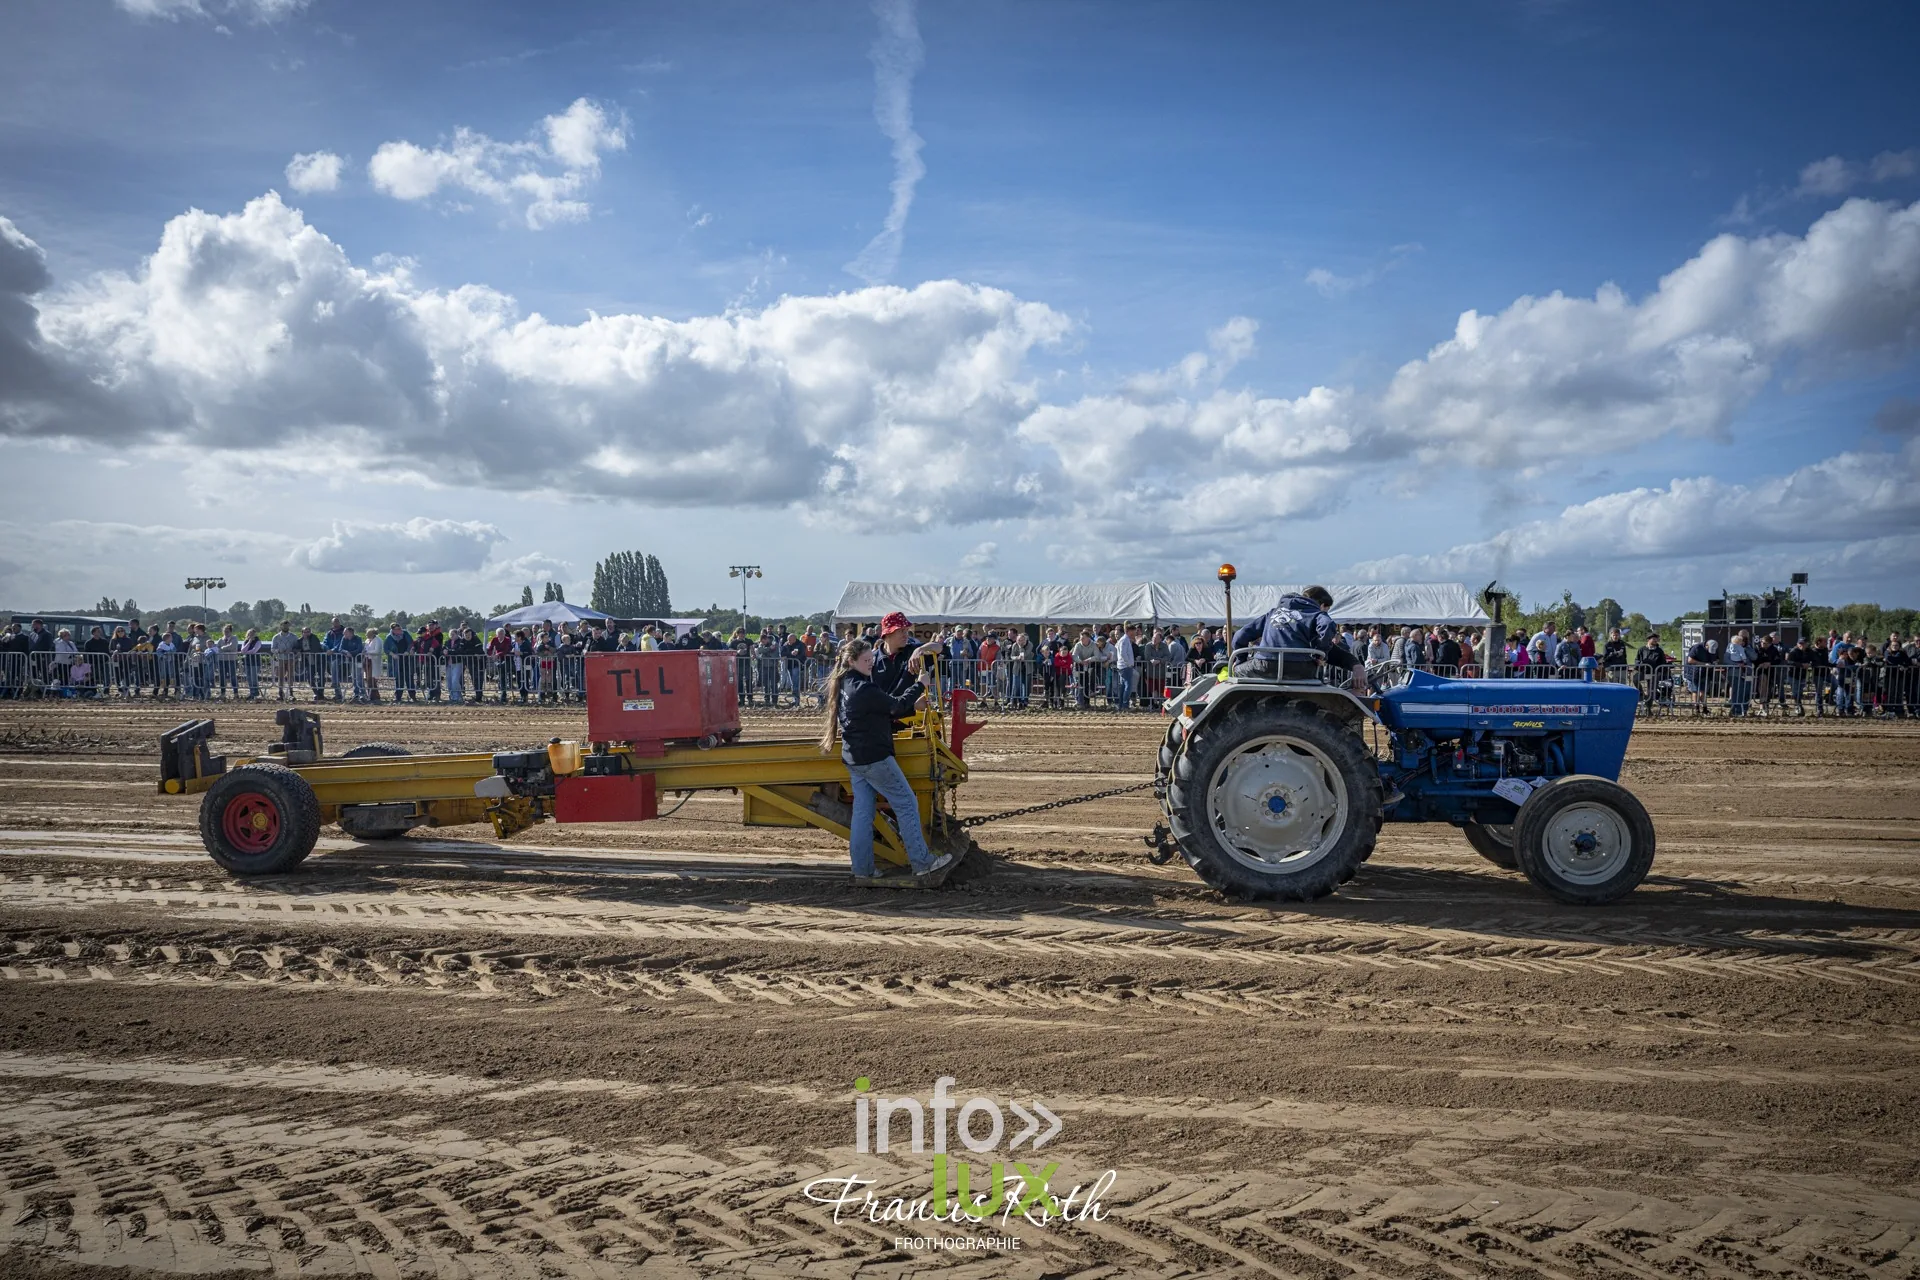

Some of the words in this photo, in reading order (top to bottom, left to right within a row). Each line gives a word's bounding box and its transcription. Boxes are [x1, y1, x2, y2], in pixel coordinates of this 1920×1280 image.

[607, 666, 674, 696] TLL
[1472, 704, 1524, 714] FORD
[1527, 704, 1580, 714] 2000
